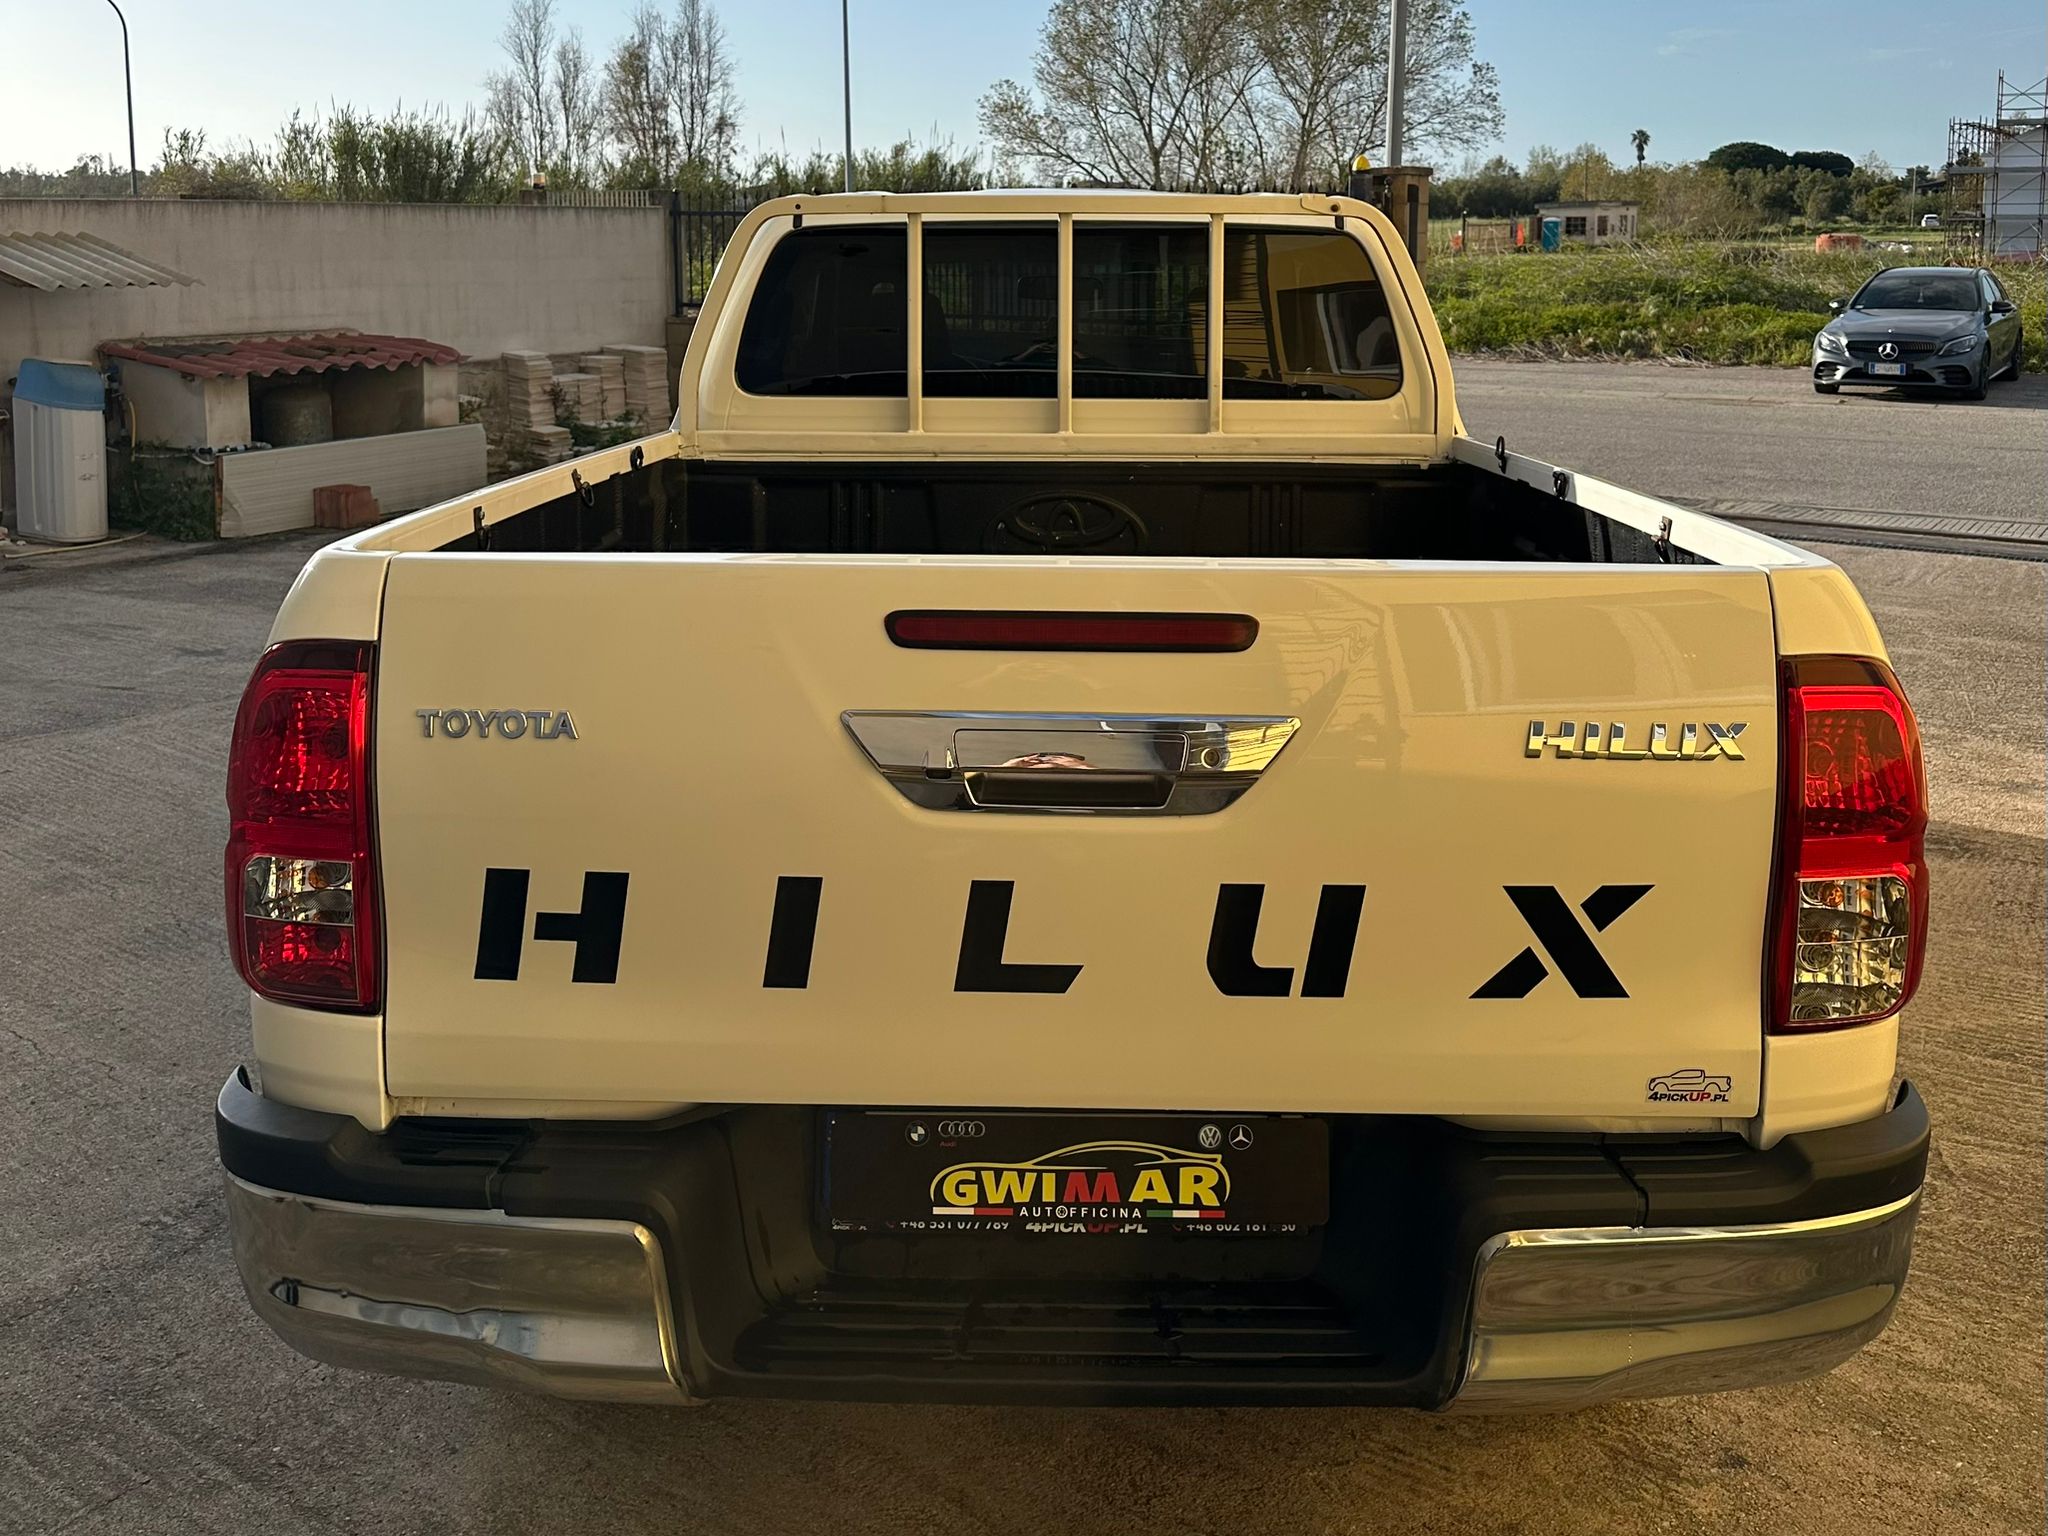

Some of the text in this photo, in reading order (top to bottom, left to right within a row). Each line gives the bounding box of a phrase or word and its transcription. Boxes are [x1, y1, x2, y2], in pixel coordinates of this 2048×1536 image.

[416, 708, 580, 740] TOYOTA
[1524, 719, 1750, 761] HILUX
[473, 866, 1657, 1000] HILUX
[1647, 1091, 1730, 1103] 4PICKUP.PL
[942, 1166, 1221, 1207] GWIMAR
[1019, 1206, 1142, 1219] AUTOFFICINA
